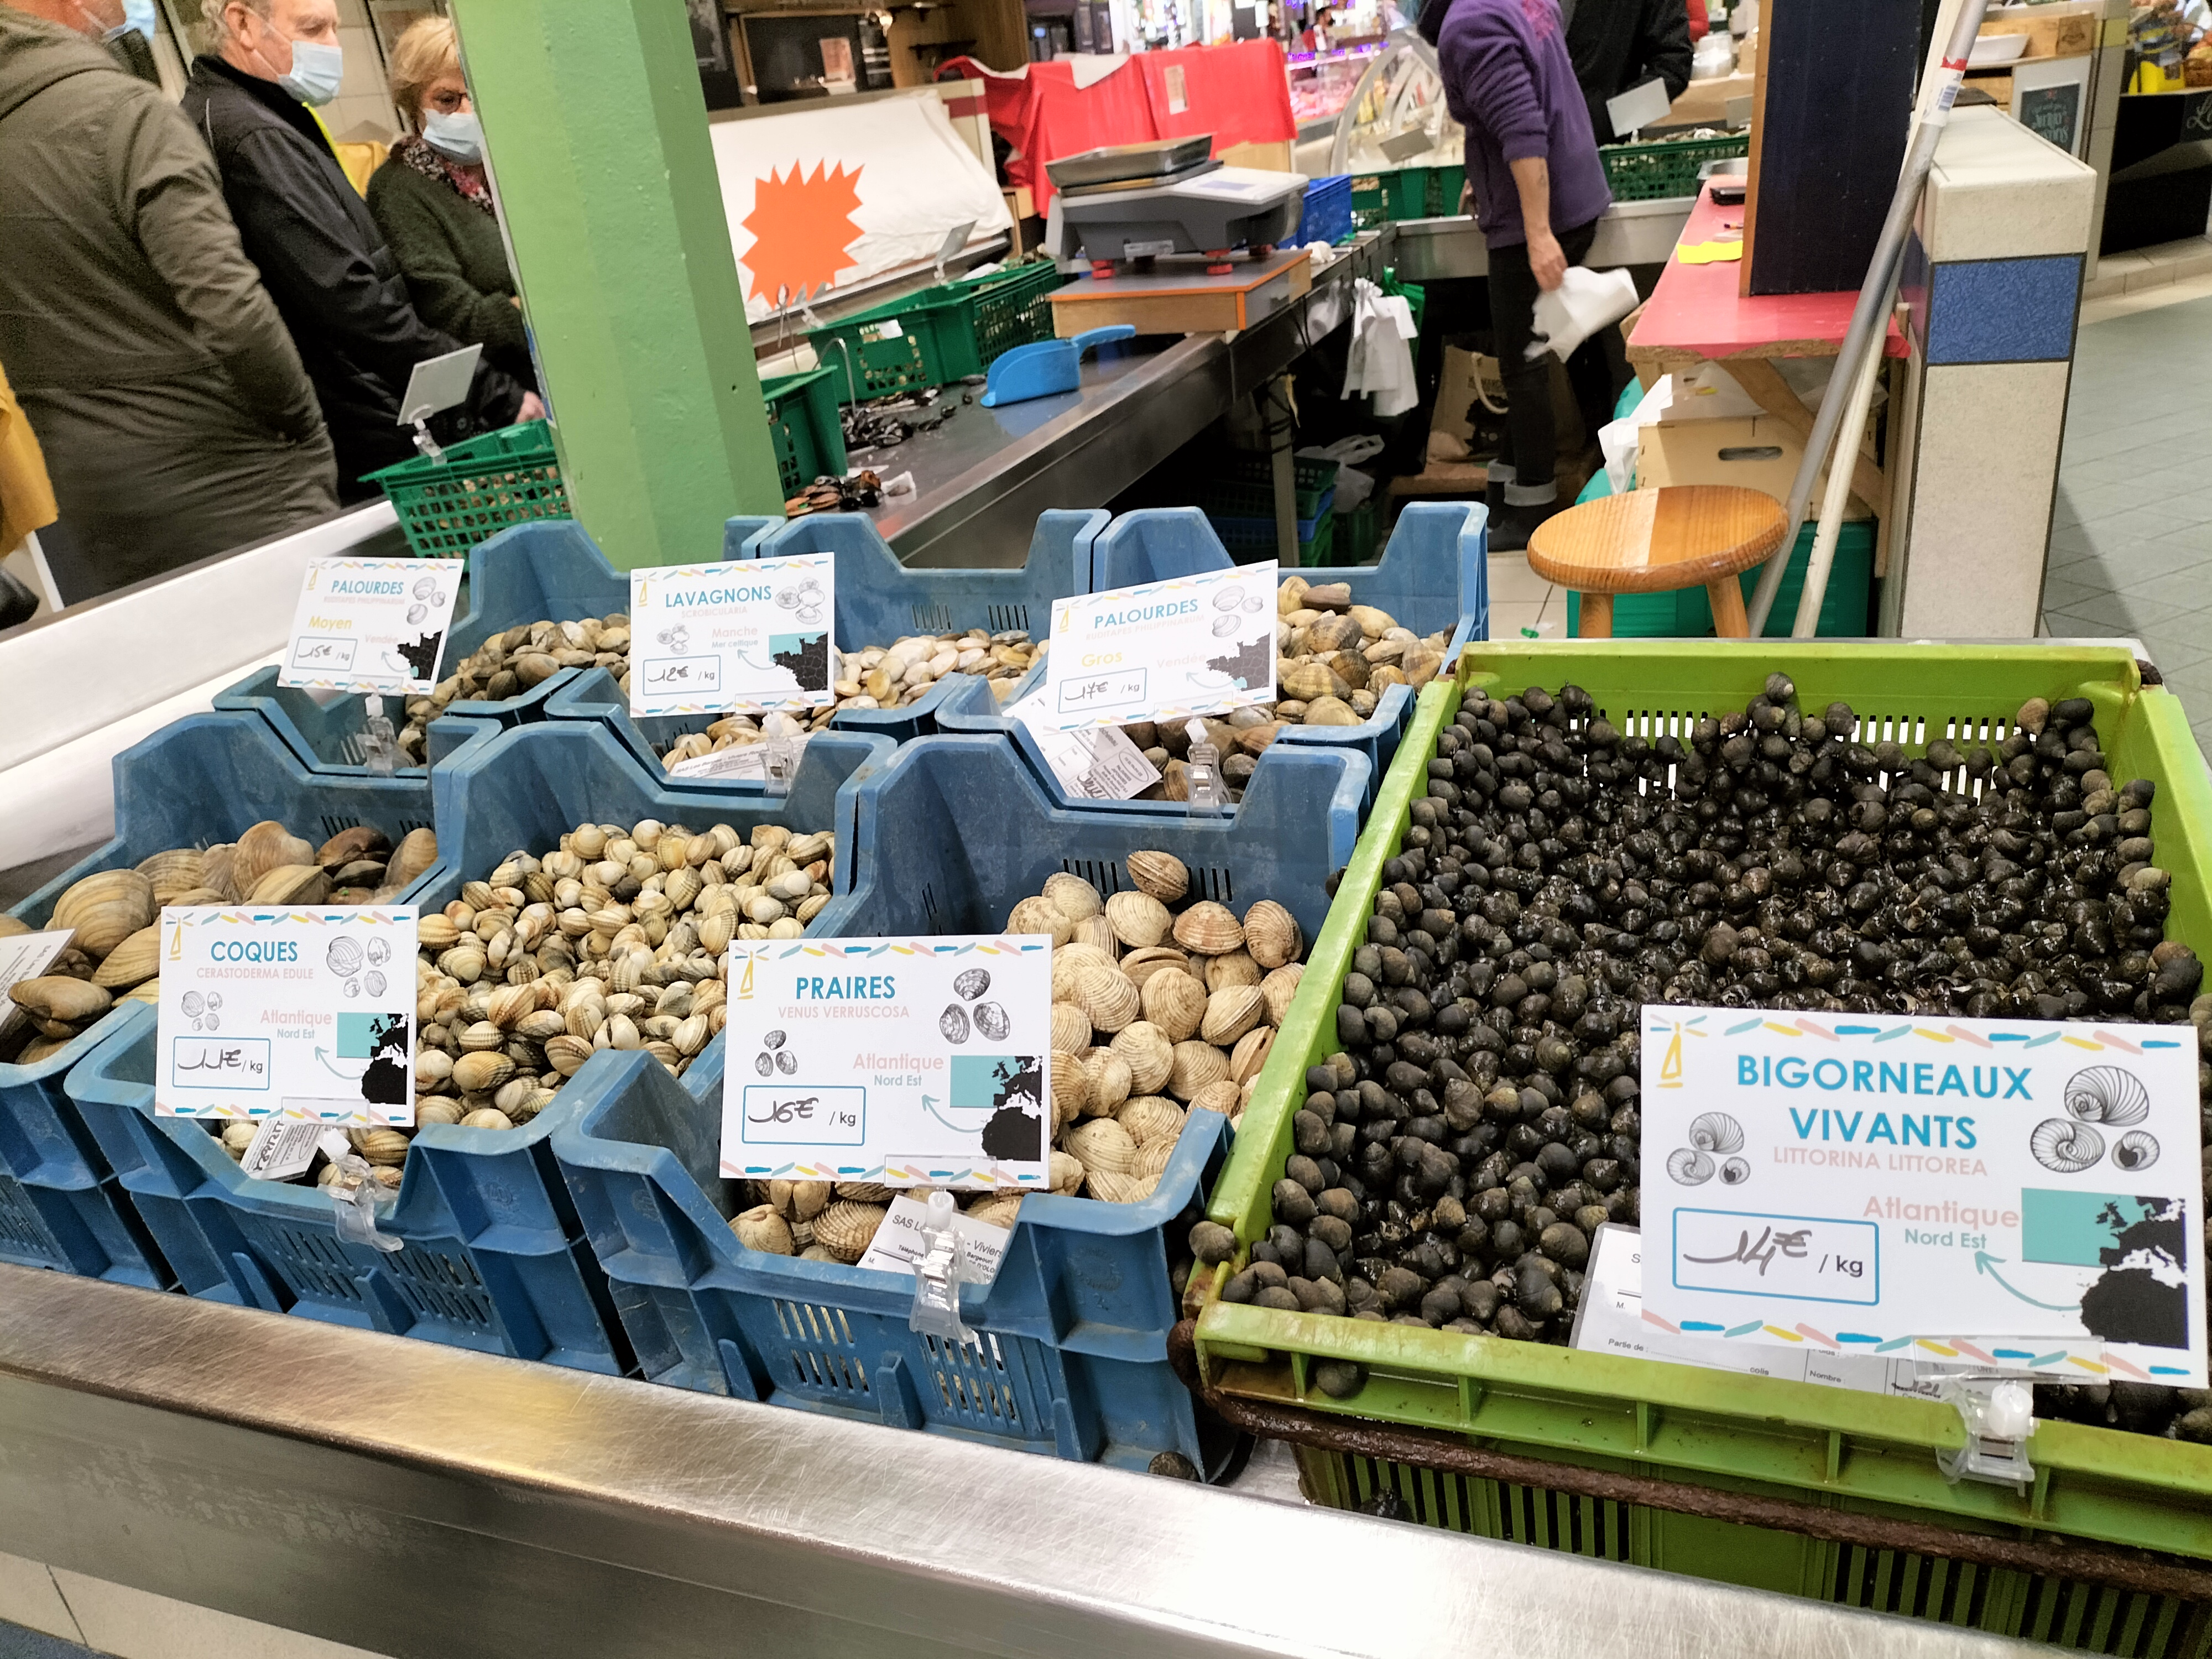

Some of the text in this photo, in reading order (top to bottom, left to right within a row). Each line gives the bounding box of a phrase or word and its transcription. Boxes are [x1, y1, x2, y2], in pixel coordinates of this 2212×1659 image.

[331, 581, 404, 595] PALOURDES
[666, 585, 771, 608] LAVAGNONS
[681, 606, 748, 619] SCROBICULARIA
[1094, 598, 1198, 629] PALOURDES
[309, 615, 352, 631] Moyen
[365, 633, 398, 644] Vendée
[712, 626, 758, 639] Manche
[298, 644, 332, 658] 15€
[711, 639, 758, 649] Mer celtique
[1082, 651, 1123, 667] Gros
[1156, 653, 1207, 669] Vendée
[211, 941, 298, 963] COQUES
[196, 967, 314, 980] CERASTODERMA EDULE
[796, 975, 896, 999] PRAIRES
[260, 1009, 332, 1028] Atlantique
[778, 1006, 910, 1019] VENUS VERRUSCOSA
[276, 1028, 315, 1039] Nord Est
[853, 1053, 944, 1073] Atlantique
[874, 1074, 922, 1087] Nord Est
[1737, 1055, 2033, 1101] BIGORNEAUX
[748, 1097, 819, 1123] 16€
[1789, 1107, 1978, 1150] VIVANTS
[1773, 1145, 1988, 1177] LITTORINA LITTOREA
[1863, 1194, 2020, 1232] Atlantique
[893, 1215, 913, 1228] SAS
[1905, 1227, 1987, 1250] Nord Est
[1683, 1225, 1813, 1277] 14€
[1608, 1338, 1631, 1349] Partie
[1634, 1343, 1644, 1352] de
[1750, 1366, 1769, 1375] colis
[1810, 1370, 1841, 1383] Nombre
